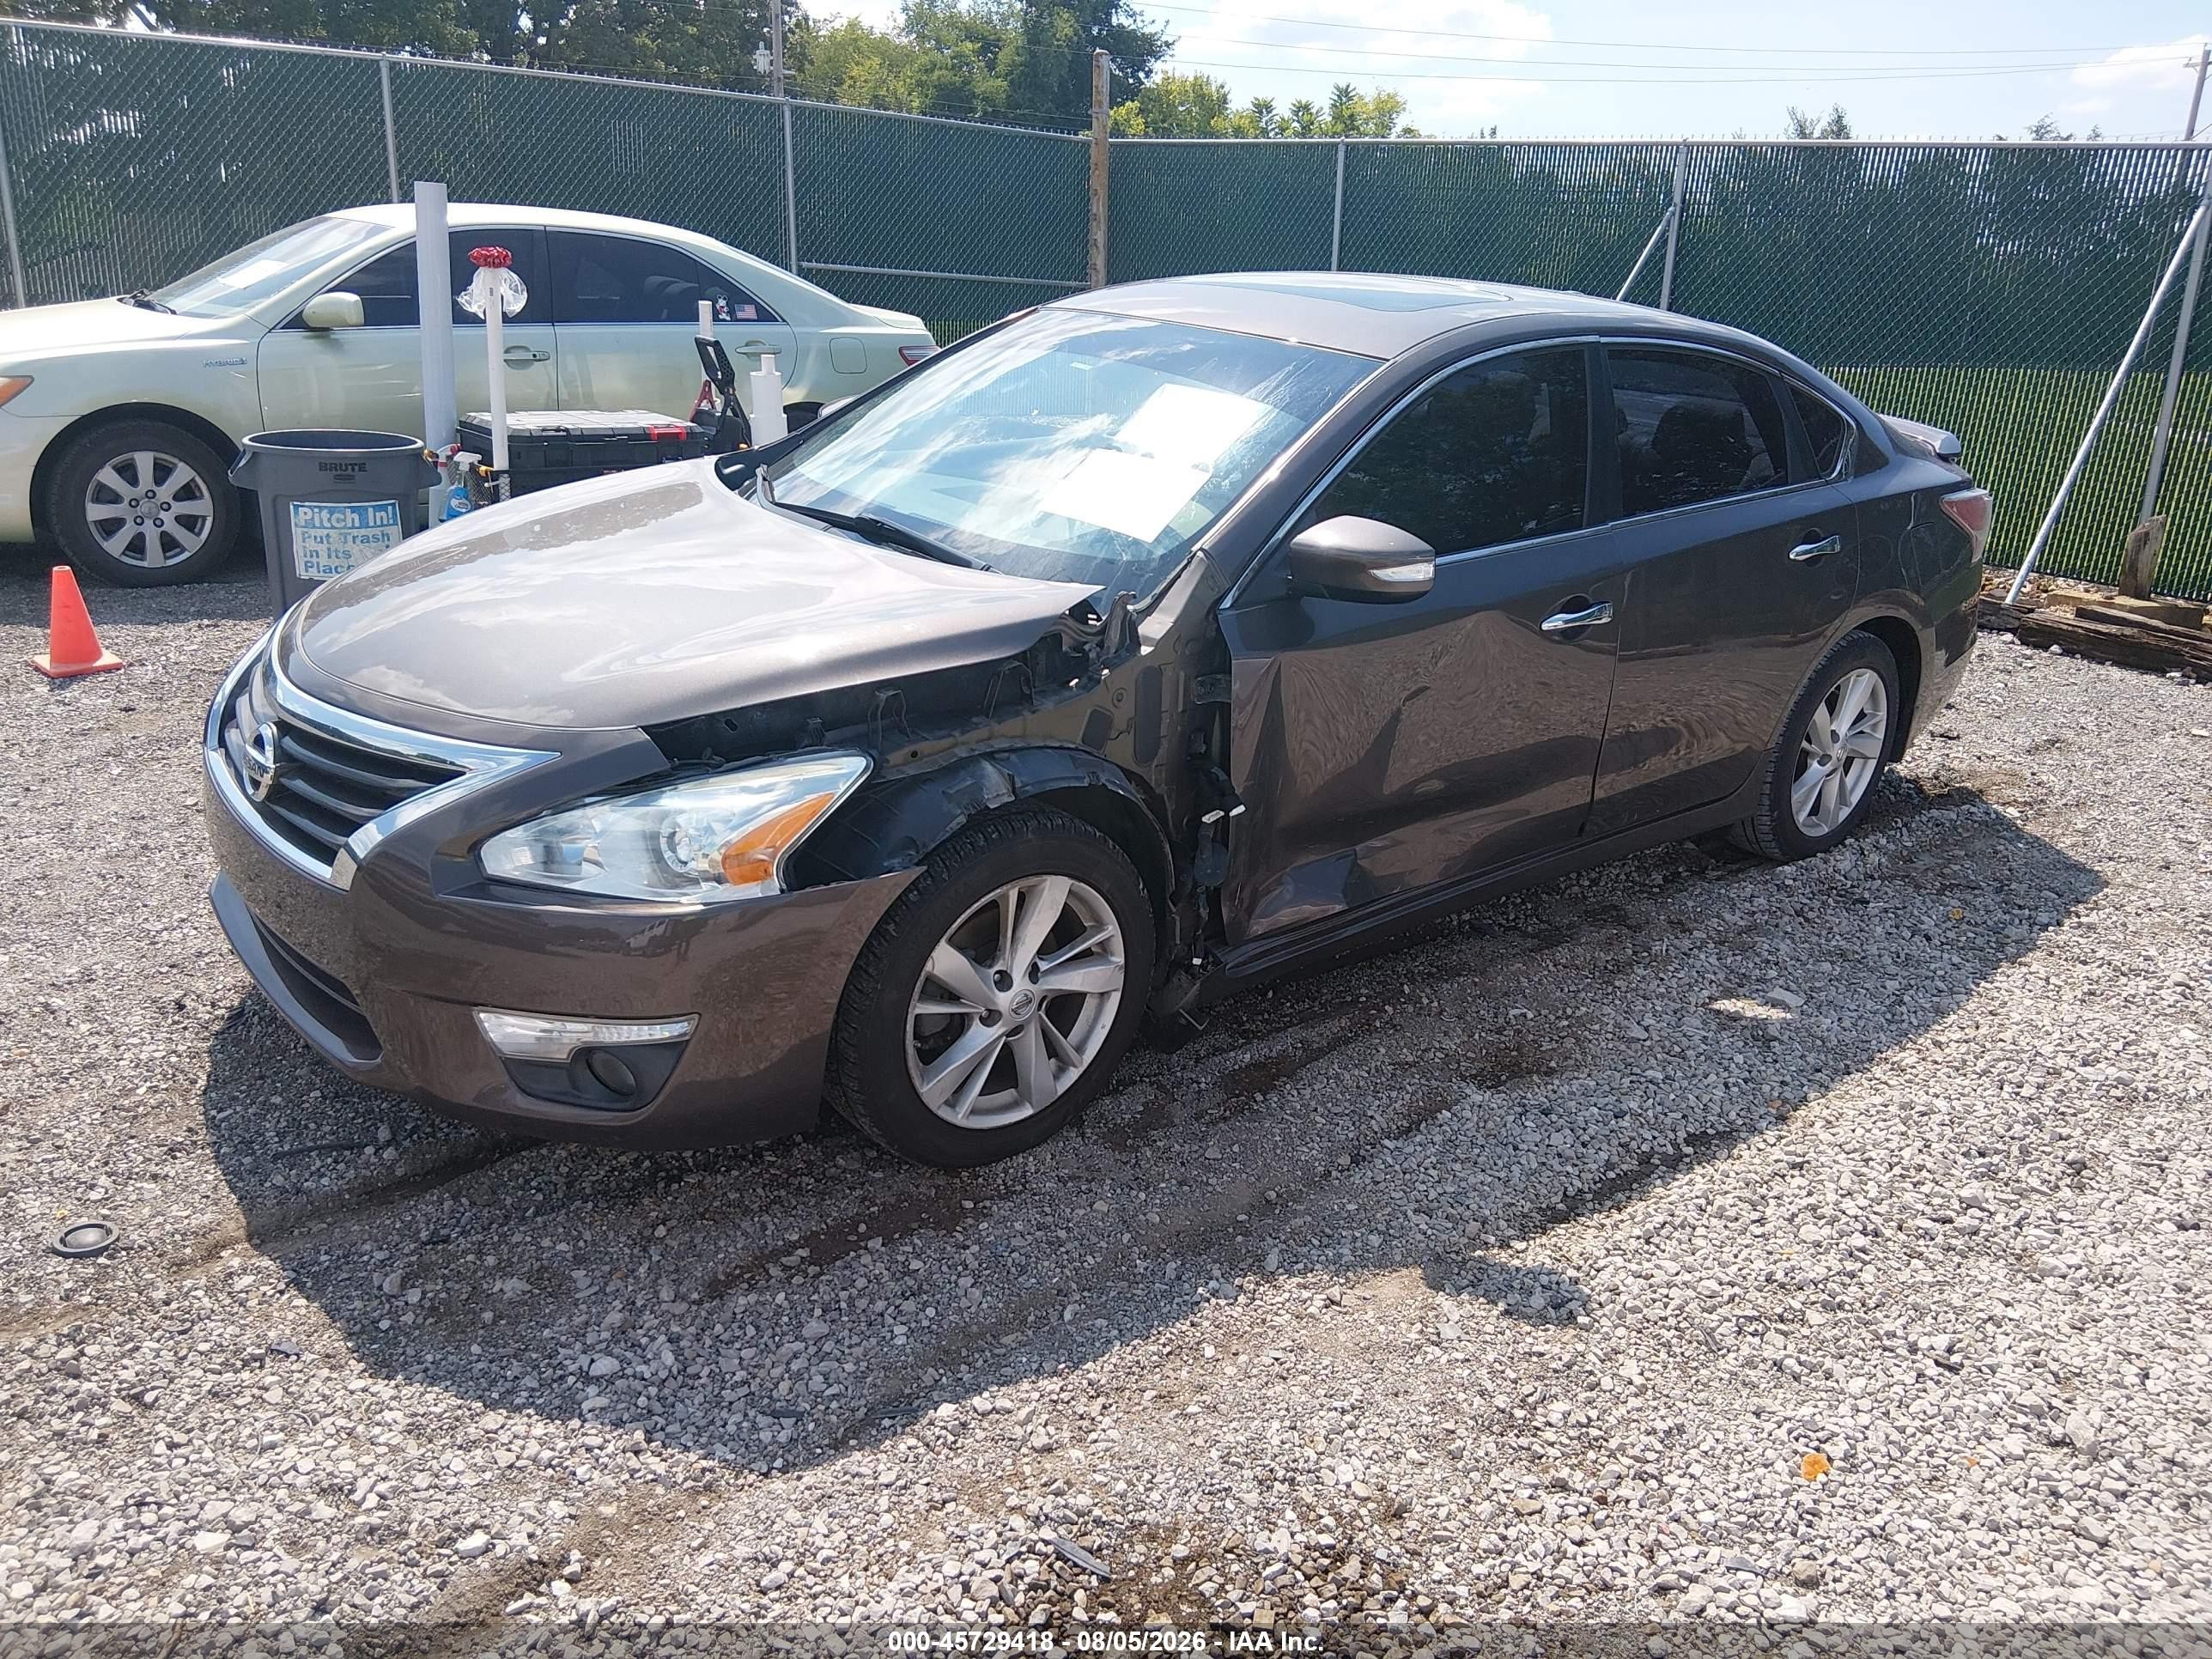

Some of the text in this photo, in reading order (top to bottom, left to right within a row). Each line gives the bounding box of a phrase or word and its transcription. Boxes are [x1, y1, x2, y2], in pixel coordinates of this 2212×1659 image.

[319, 461, 368, 472] BRUTE
[298, 505, 394, 528] Pitch In!
[301, 530, 391, 545] Put Trash
